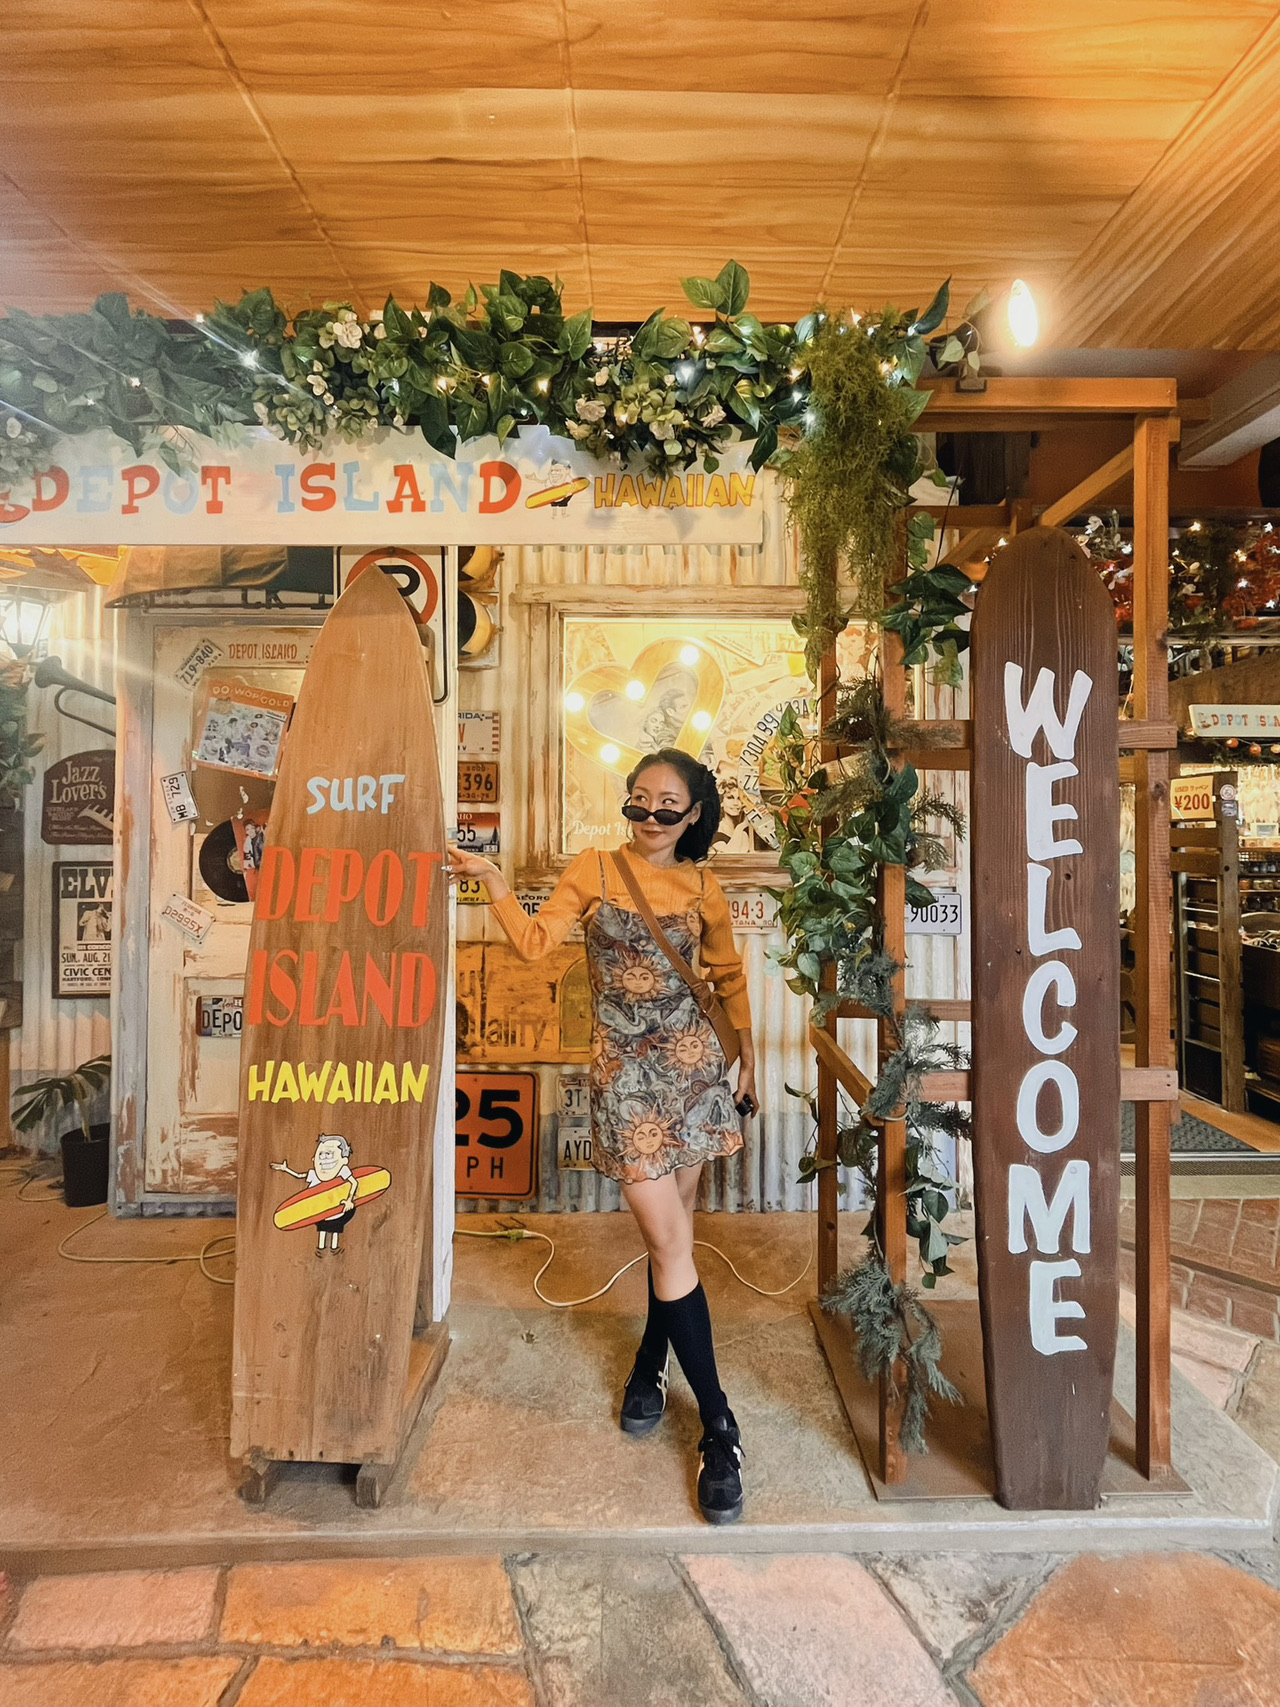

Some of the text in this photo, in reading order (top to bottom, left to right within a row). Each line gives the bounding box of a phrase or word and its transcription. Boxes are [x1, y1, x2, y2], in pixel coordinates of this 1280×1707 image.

[32, 460, 522, 515] DEPOT ISLAND
[593, 472, 756, 509] HAWAIIAN
[228, 643, 298, 660] DEPOT ISLAND
[1210, 713, 1248, 726] DEPOT
[62, 761, 100, 785] Jazz
[463, 773, 493, 791] 396
[50, 779, 108, 803] Lover's
[168, 776, 182, 798] 729
[306, 773, 405, 815] SURF
[1174, 793, 1210, 811] ¥200
[573, 821, 611, 840] Depot
[61, 868, 113, 899] ELV
[256, 847, 442, 928] DEPOT
[911, 904, 959, 923] 90033
[63, 967, 111, 976] CIVIC CEN
[247, 949, 437, 1029] ISLAND
[1004, 661, 1094, 1356] WELCOME
[202, 1009, 243, 1033] DEPO
[248, 1059, 429, 1105] HAWAIIAN
